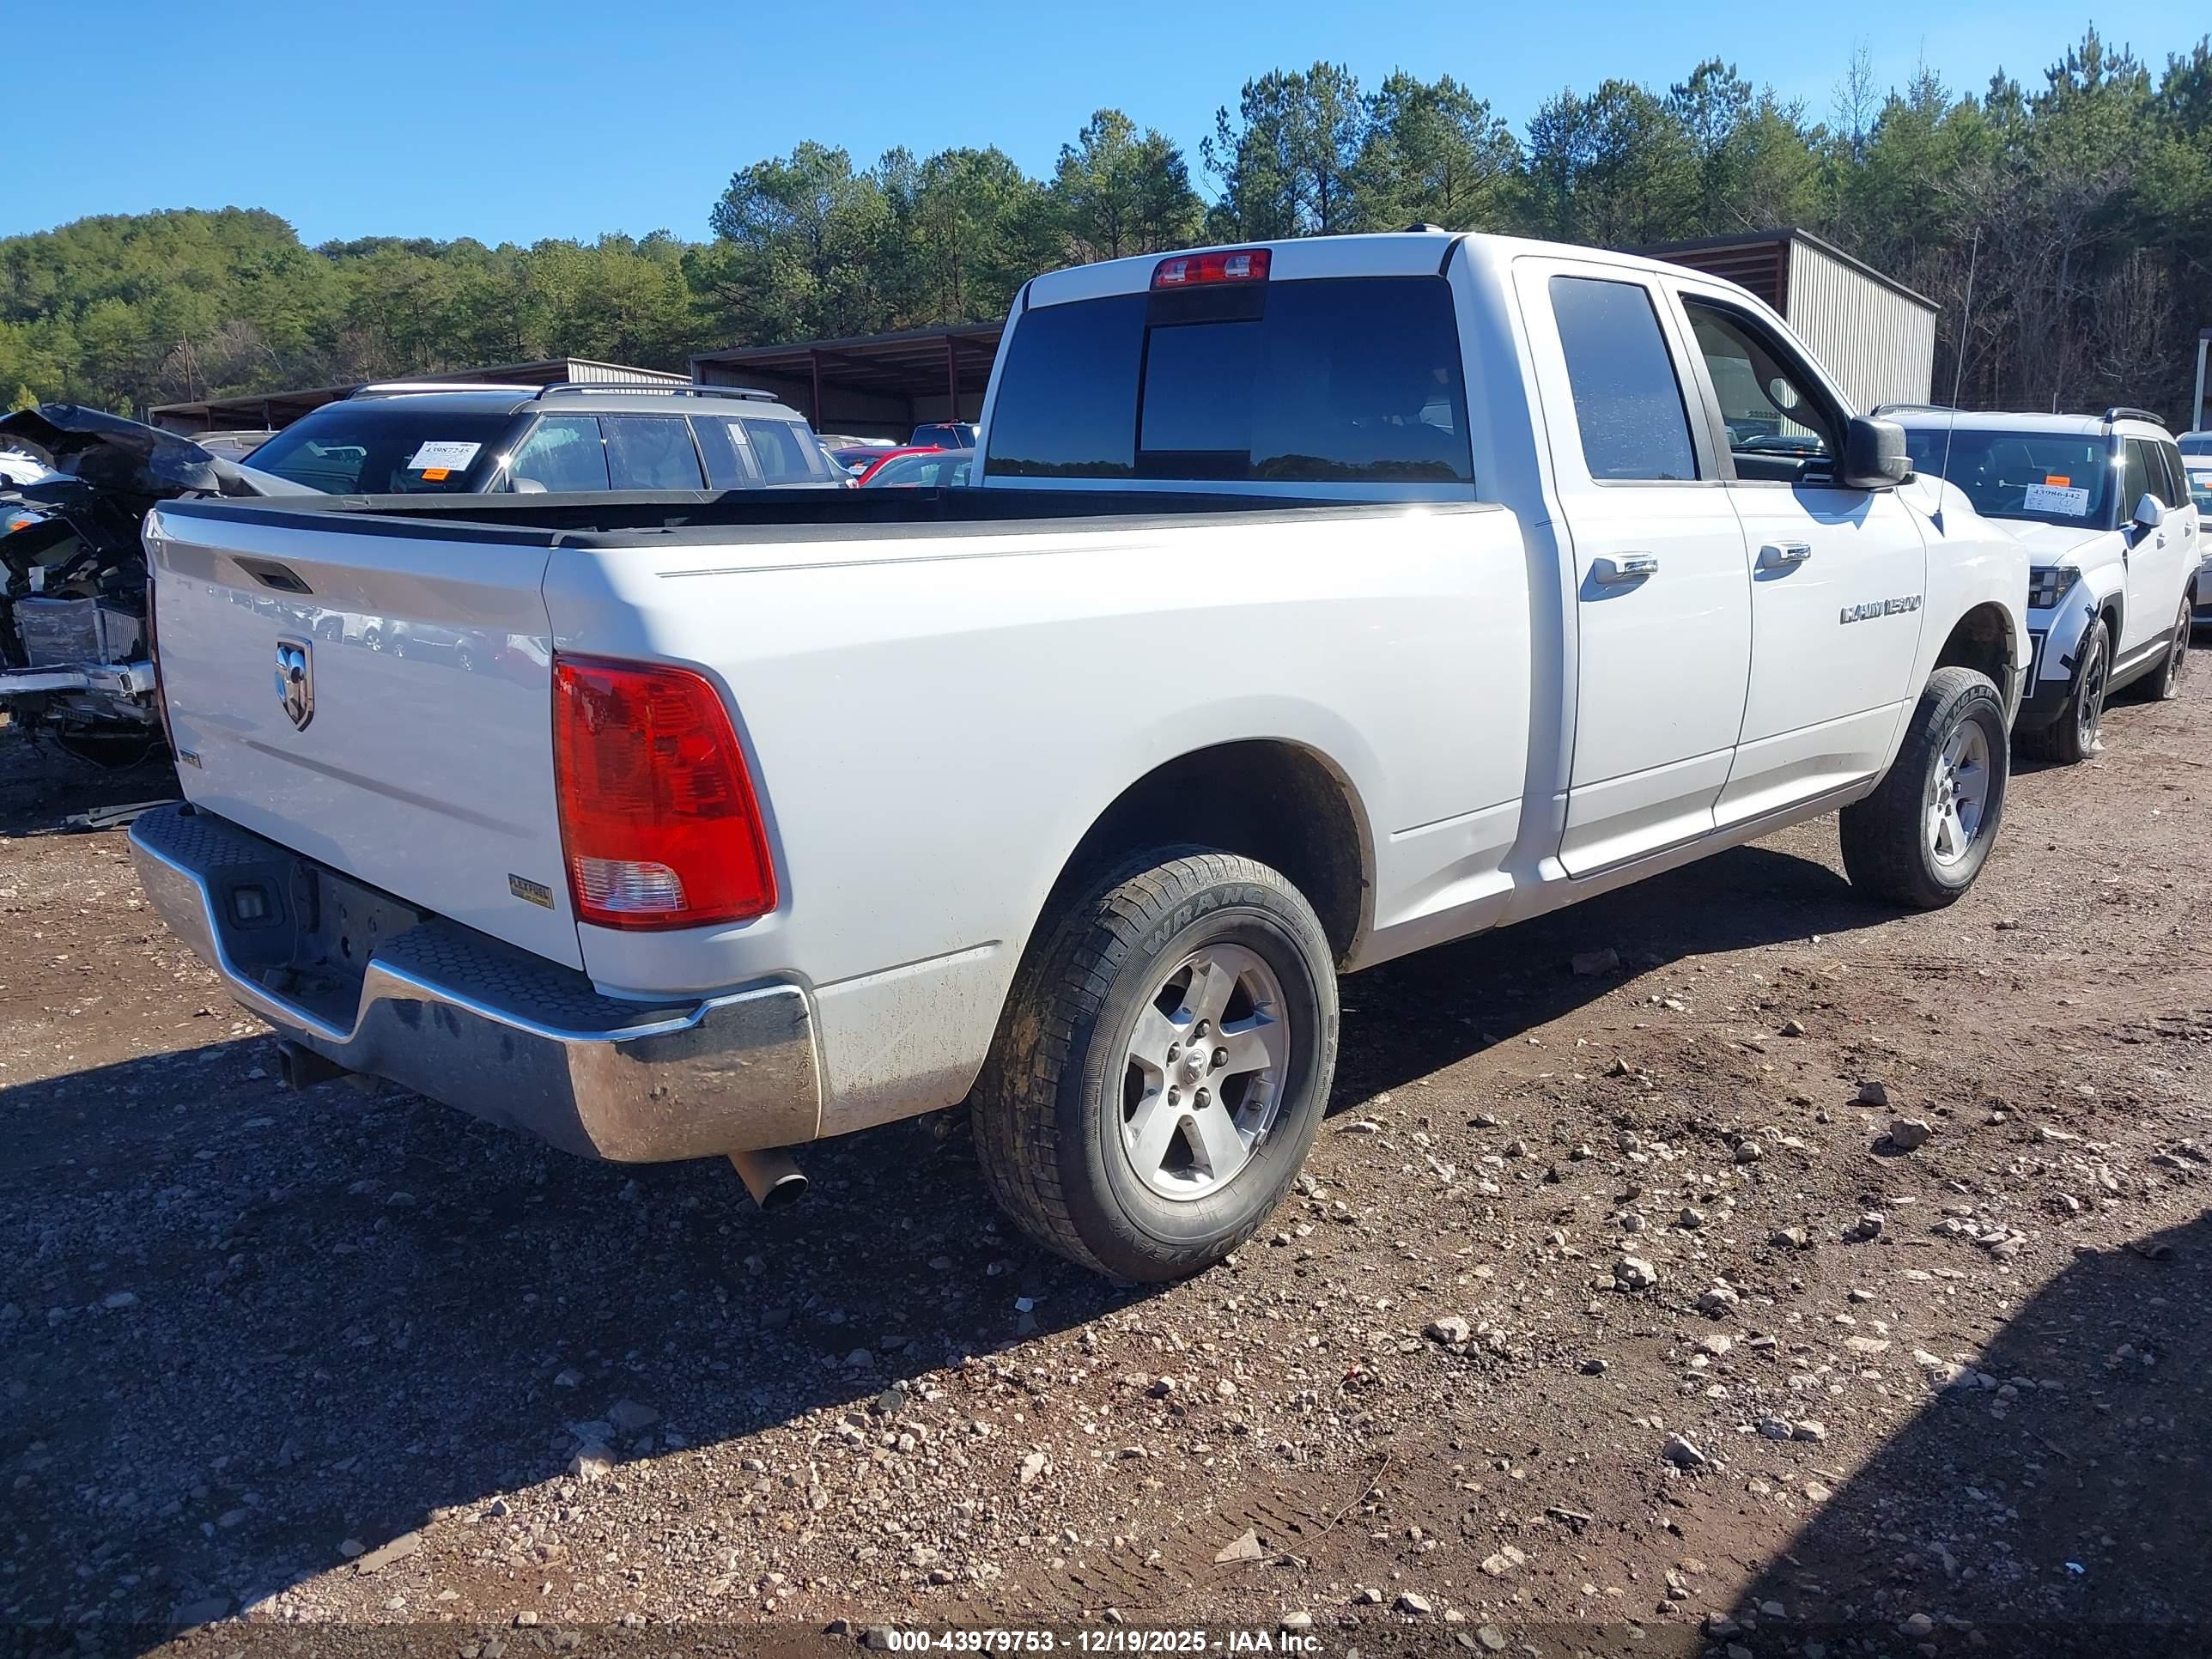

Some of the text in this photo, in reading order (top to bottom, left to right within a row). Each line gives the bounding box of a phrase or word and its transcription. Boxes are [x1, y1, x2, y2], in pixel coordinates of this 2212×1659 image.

[1839, 594, 1922, 625] RAM 1500
[1143, 886, 1315, 956] WRANGLER
